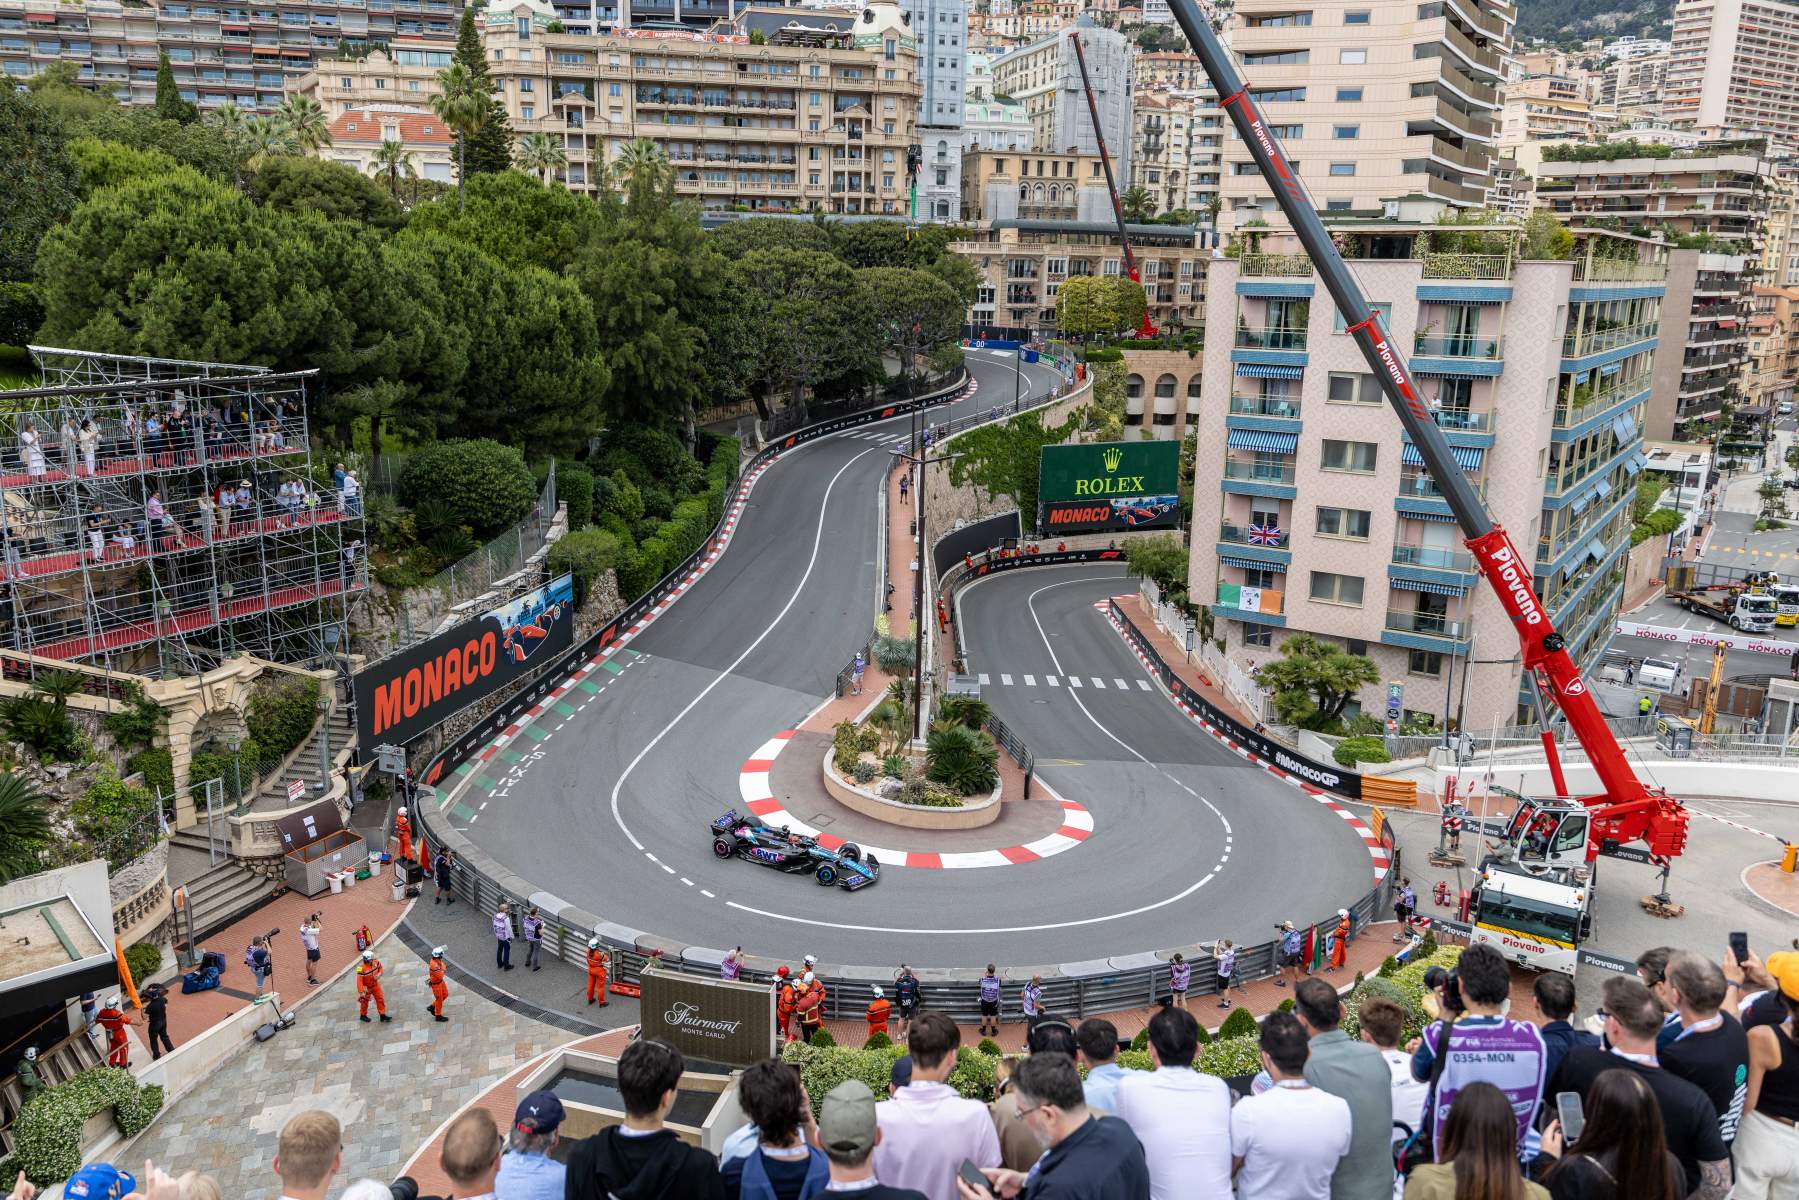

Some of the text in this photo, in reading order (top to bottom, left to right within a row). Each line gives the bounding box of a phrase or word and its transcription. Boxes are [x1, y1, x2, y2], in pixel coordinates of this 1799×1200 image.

[1251, 120, 1275, 157] Piovano
[1376, 341, 1404, 384] Piovano
[1075, 476, 1145, 495] ROLEX
[1050, 506, 1110, 524] MONACO
[1490, 546, 1542, 625] Piovano
[1635, 630, 1678, 641] MONACO
[1691, 637, 1734, 648] MONAO
[1747, 644, 1792, 656] MONACO
[374, 631, 496, 736] MONACO
[1467, 823, 1500, 836] Pioano
[1441, 924, 1472, 939] Piovan
[1502, 937, 1545, 954] Piovano
[1585, 955, 1625, 972] Piovano
[664, 1001, 743, 1034] Fairmont
[681, 1027, 726, 1039] MONTE CARLO
[1453, 1053, 1515, 1062] 0354-MON
